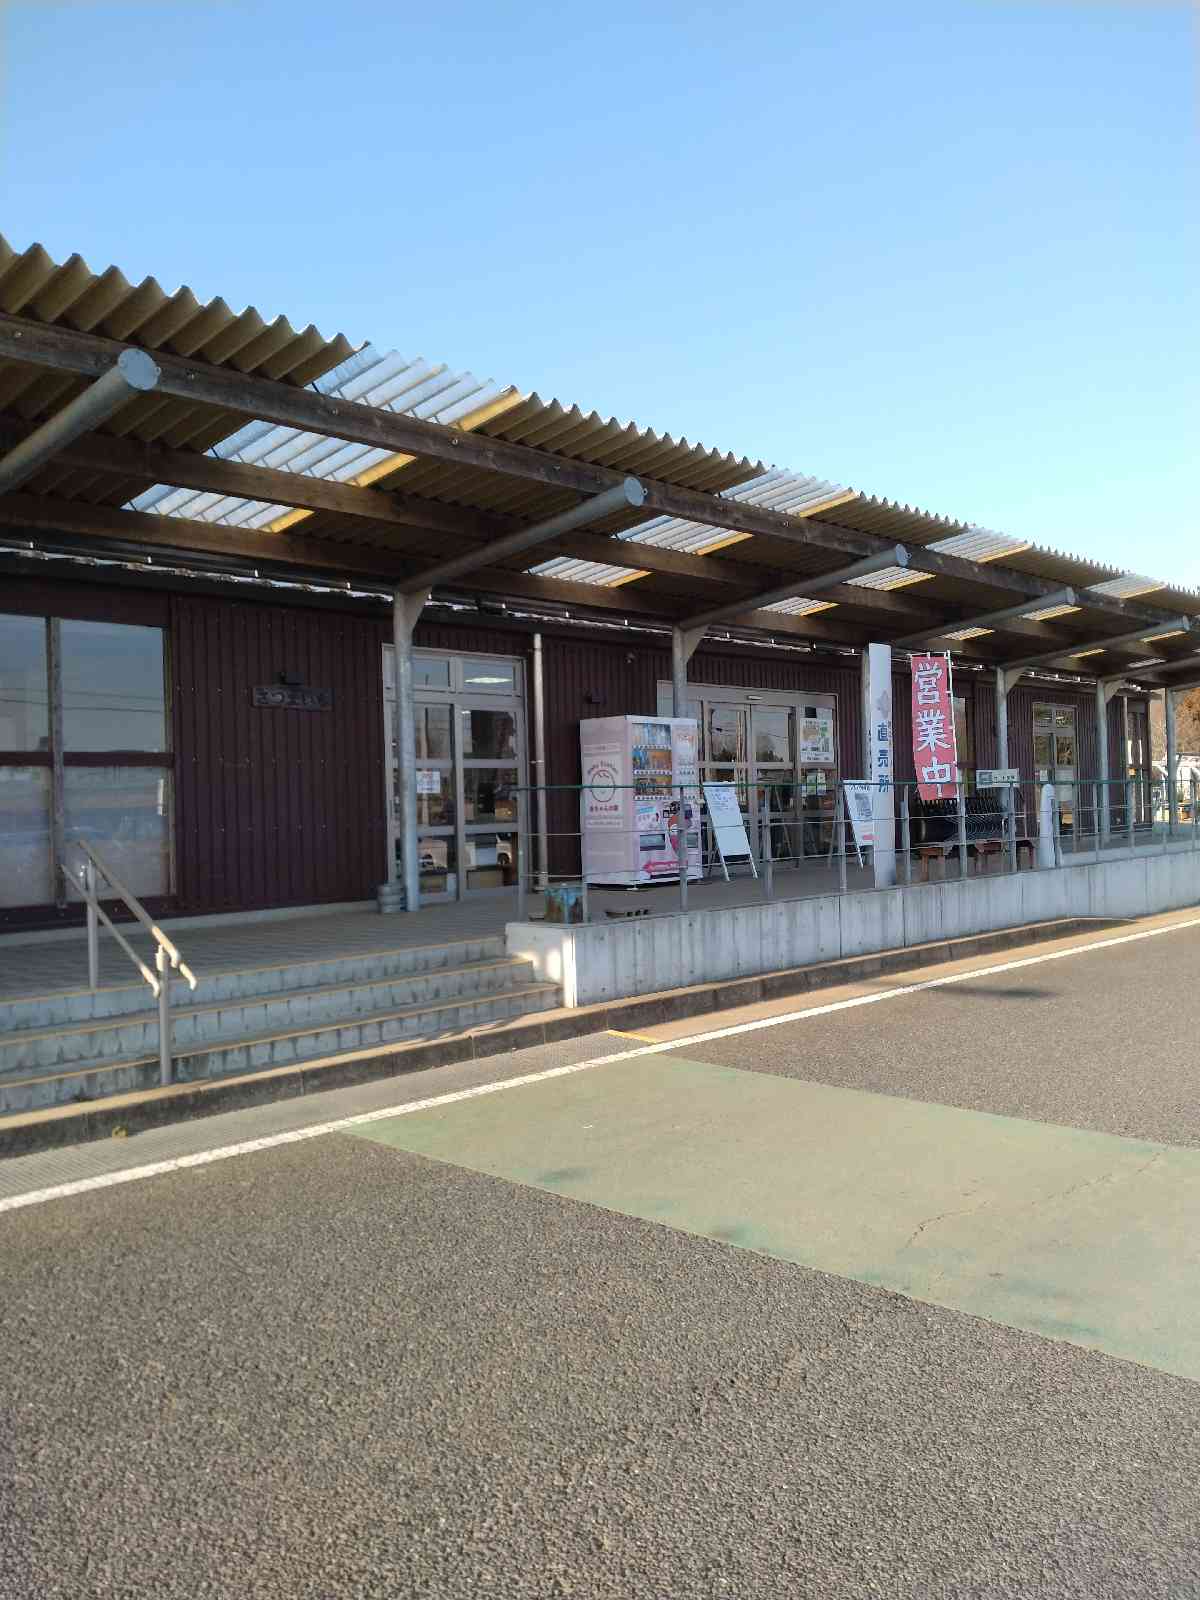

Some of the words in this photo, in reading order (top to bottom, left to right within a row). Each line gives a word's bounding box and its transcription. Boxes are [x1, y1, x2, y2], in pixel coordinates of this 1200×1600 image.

[877, 722, 889, 793] 直売所
[914, 662, 952, 798] 営業中
